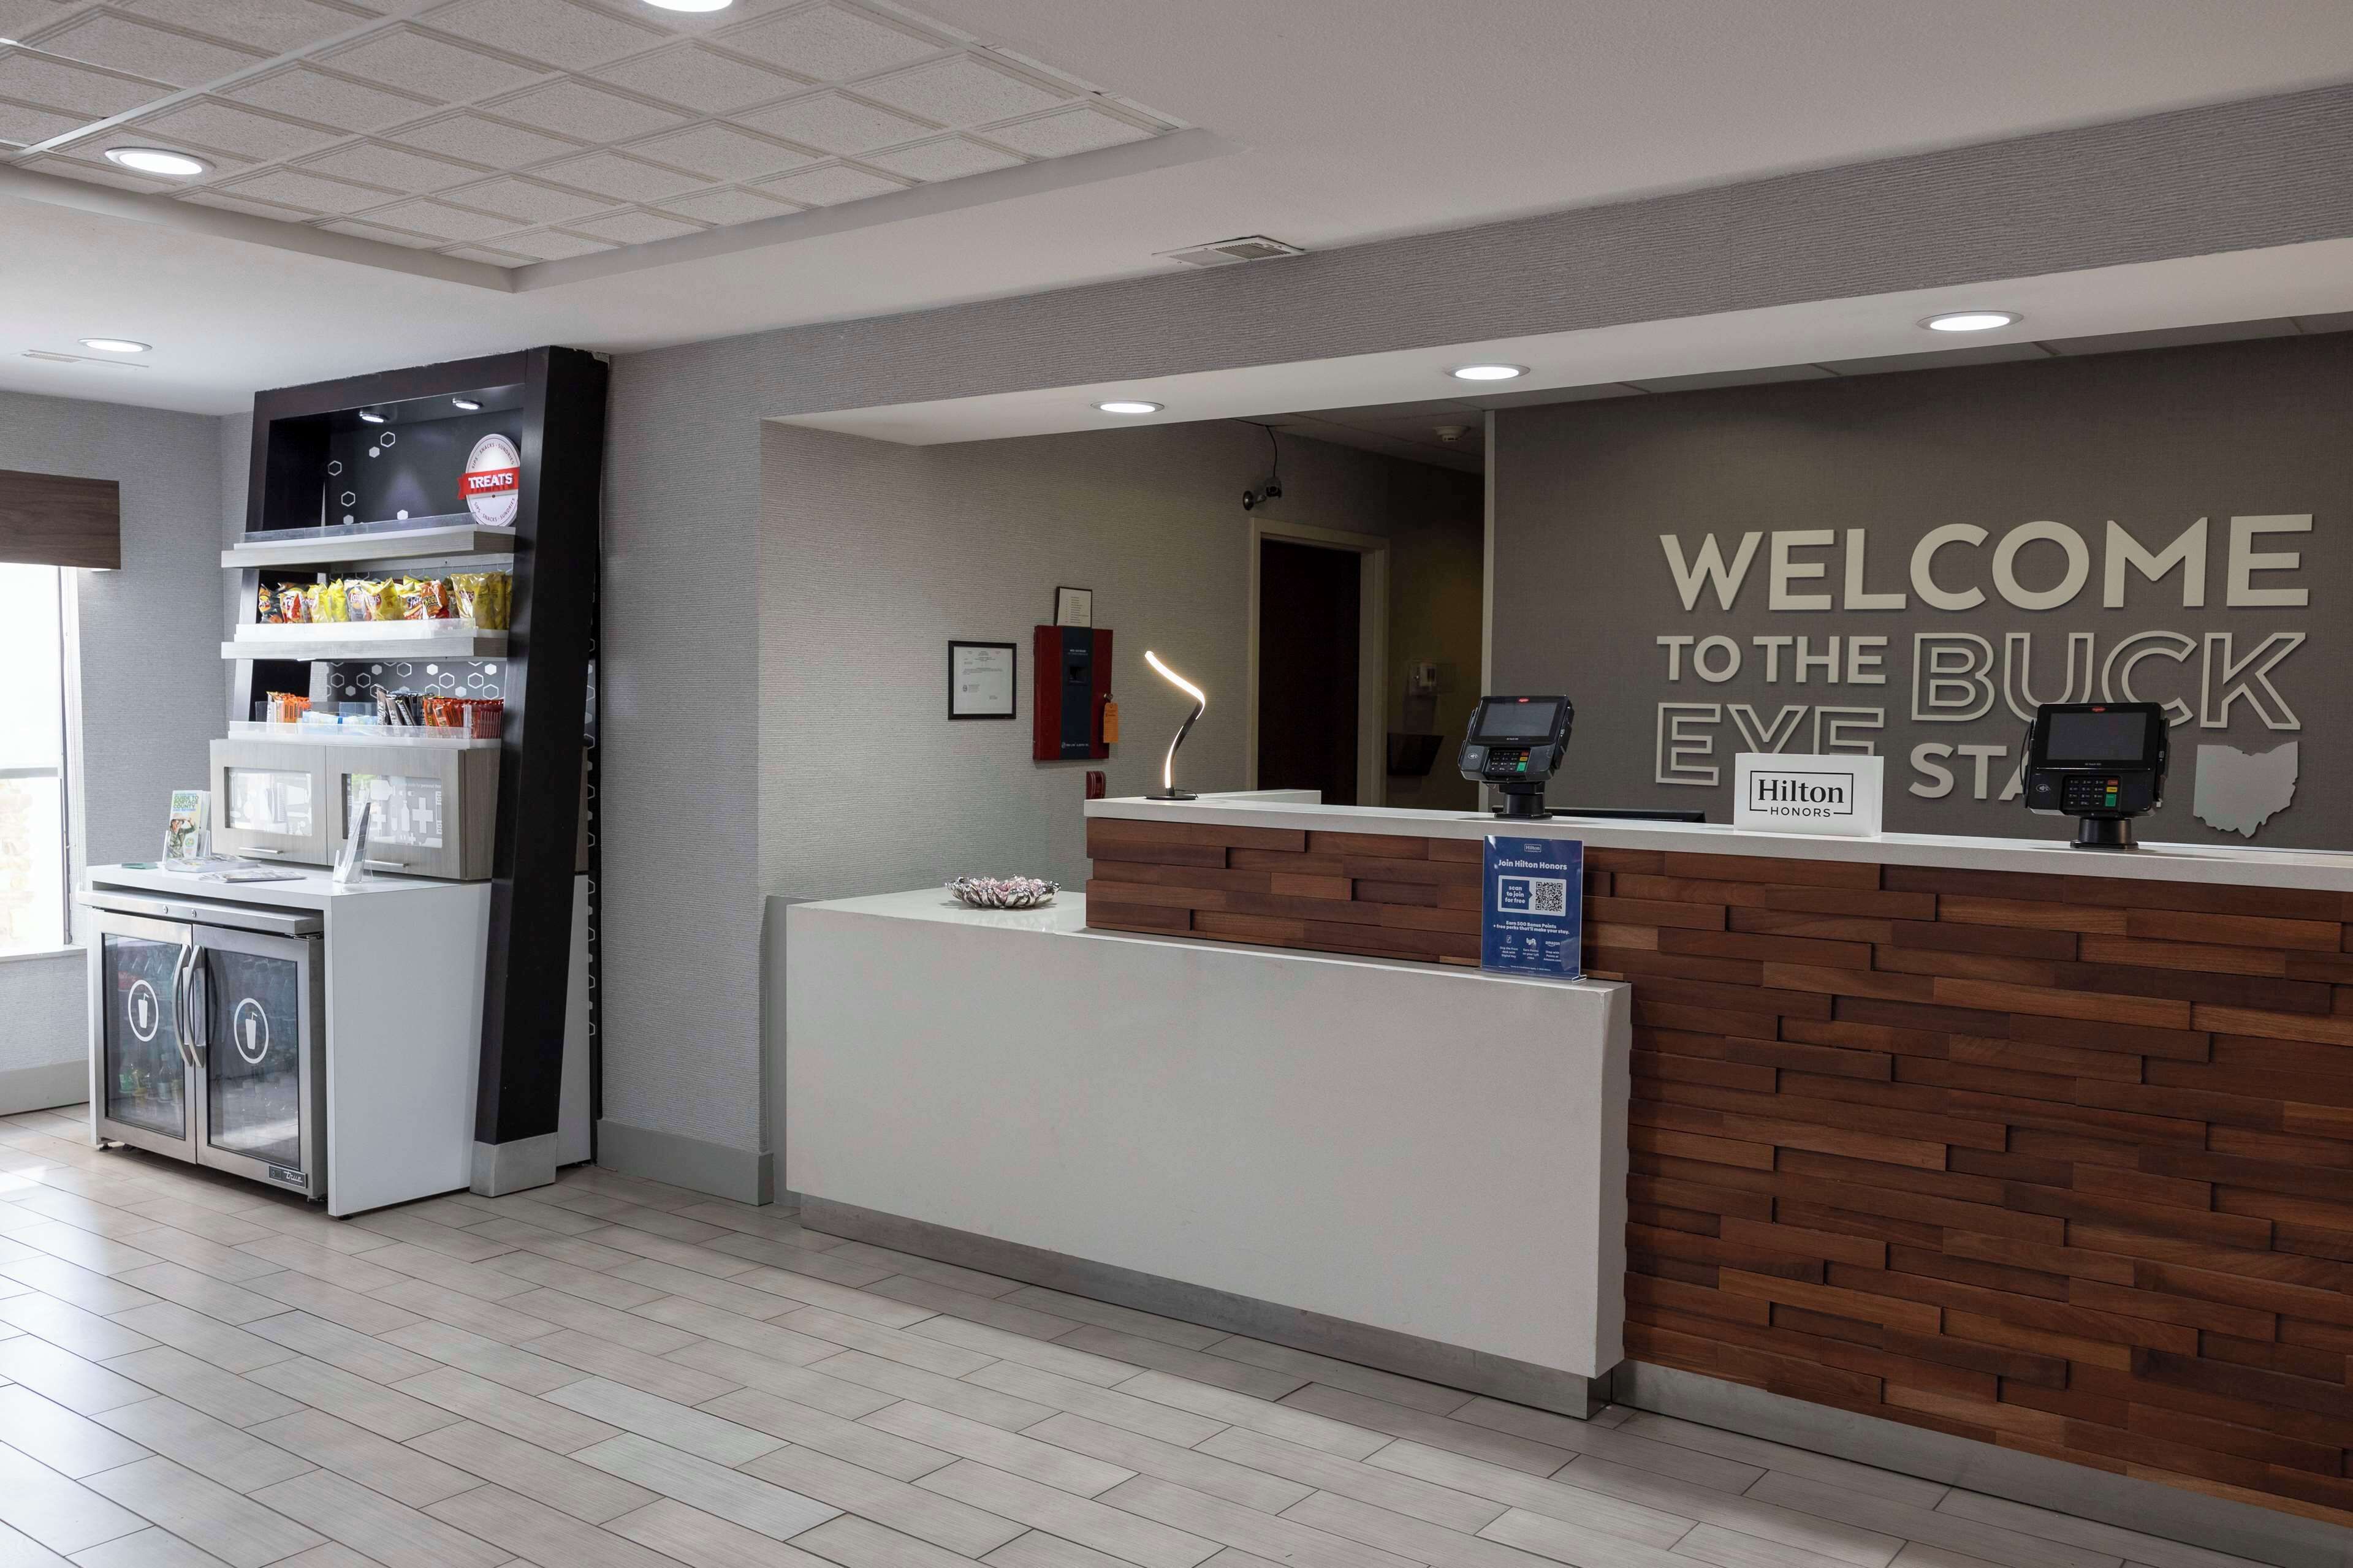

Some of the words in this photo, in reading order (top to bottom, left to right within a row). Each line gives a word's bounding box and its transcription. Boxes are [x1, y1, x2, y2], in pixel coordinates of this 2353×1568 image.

[479, 443, 495, 454] SNACKS
[498, 444, 514, 464] SUNDRIES
[468, 473, 514, 488] TREATS
[483, 513, 497, 522] SNACKS
[500, 498, 515, 520] SUNDRIES
[1659, 514, 2313, 612] WELCOME
[1657, 635, 1741, 683] TO
[1753, 636, 1888, 684] THE
[1911, 631, 2306, 730] BUCK
[1758, 779, 1844, 803] Hilton
[1771, 806, 1831, 817] HONORS
[1515, 860, 1538, 868] Hilton
[1540, 862, 1567, 870] Honors
[283, 1171, 303, 1183] true
